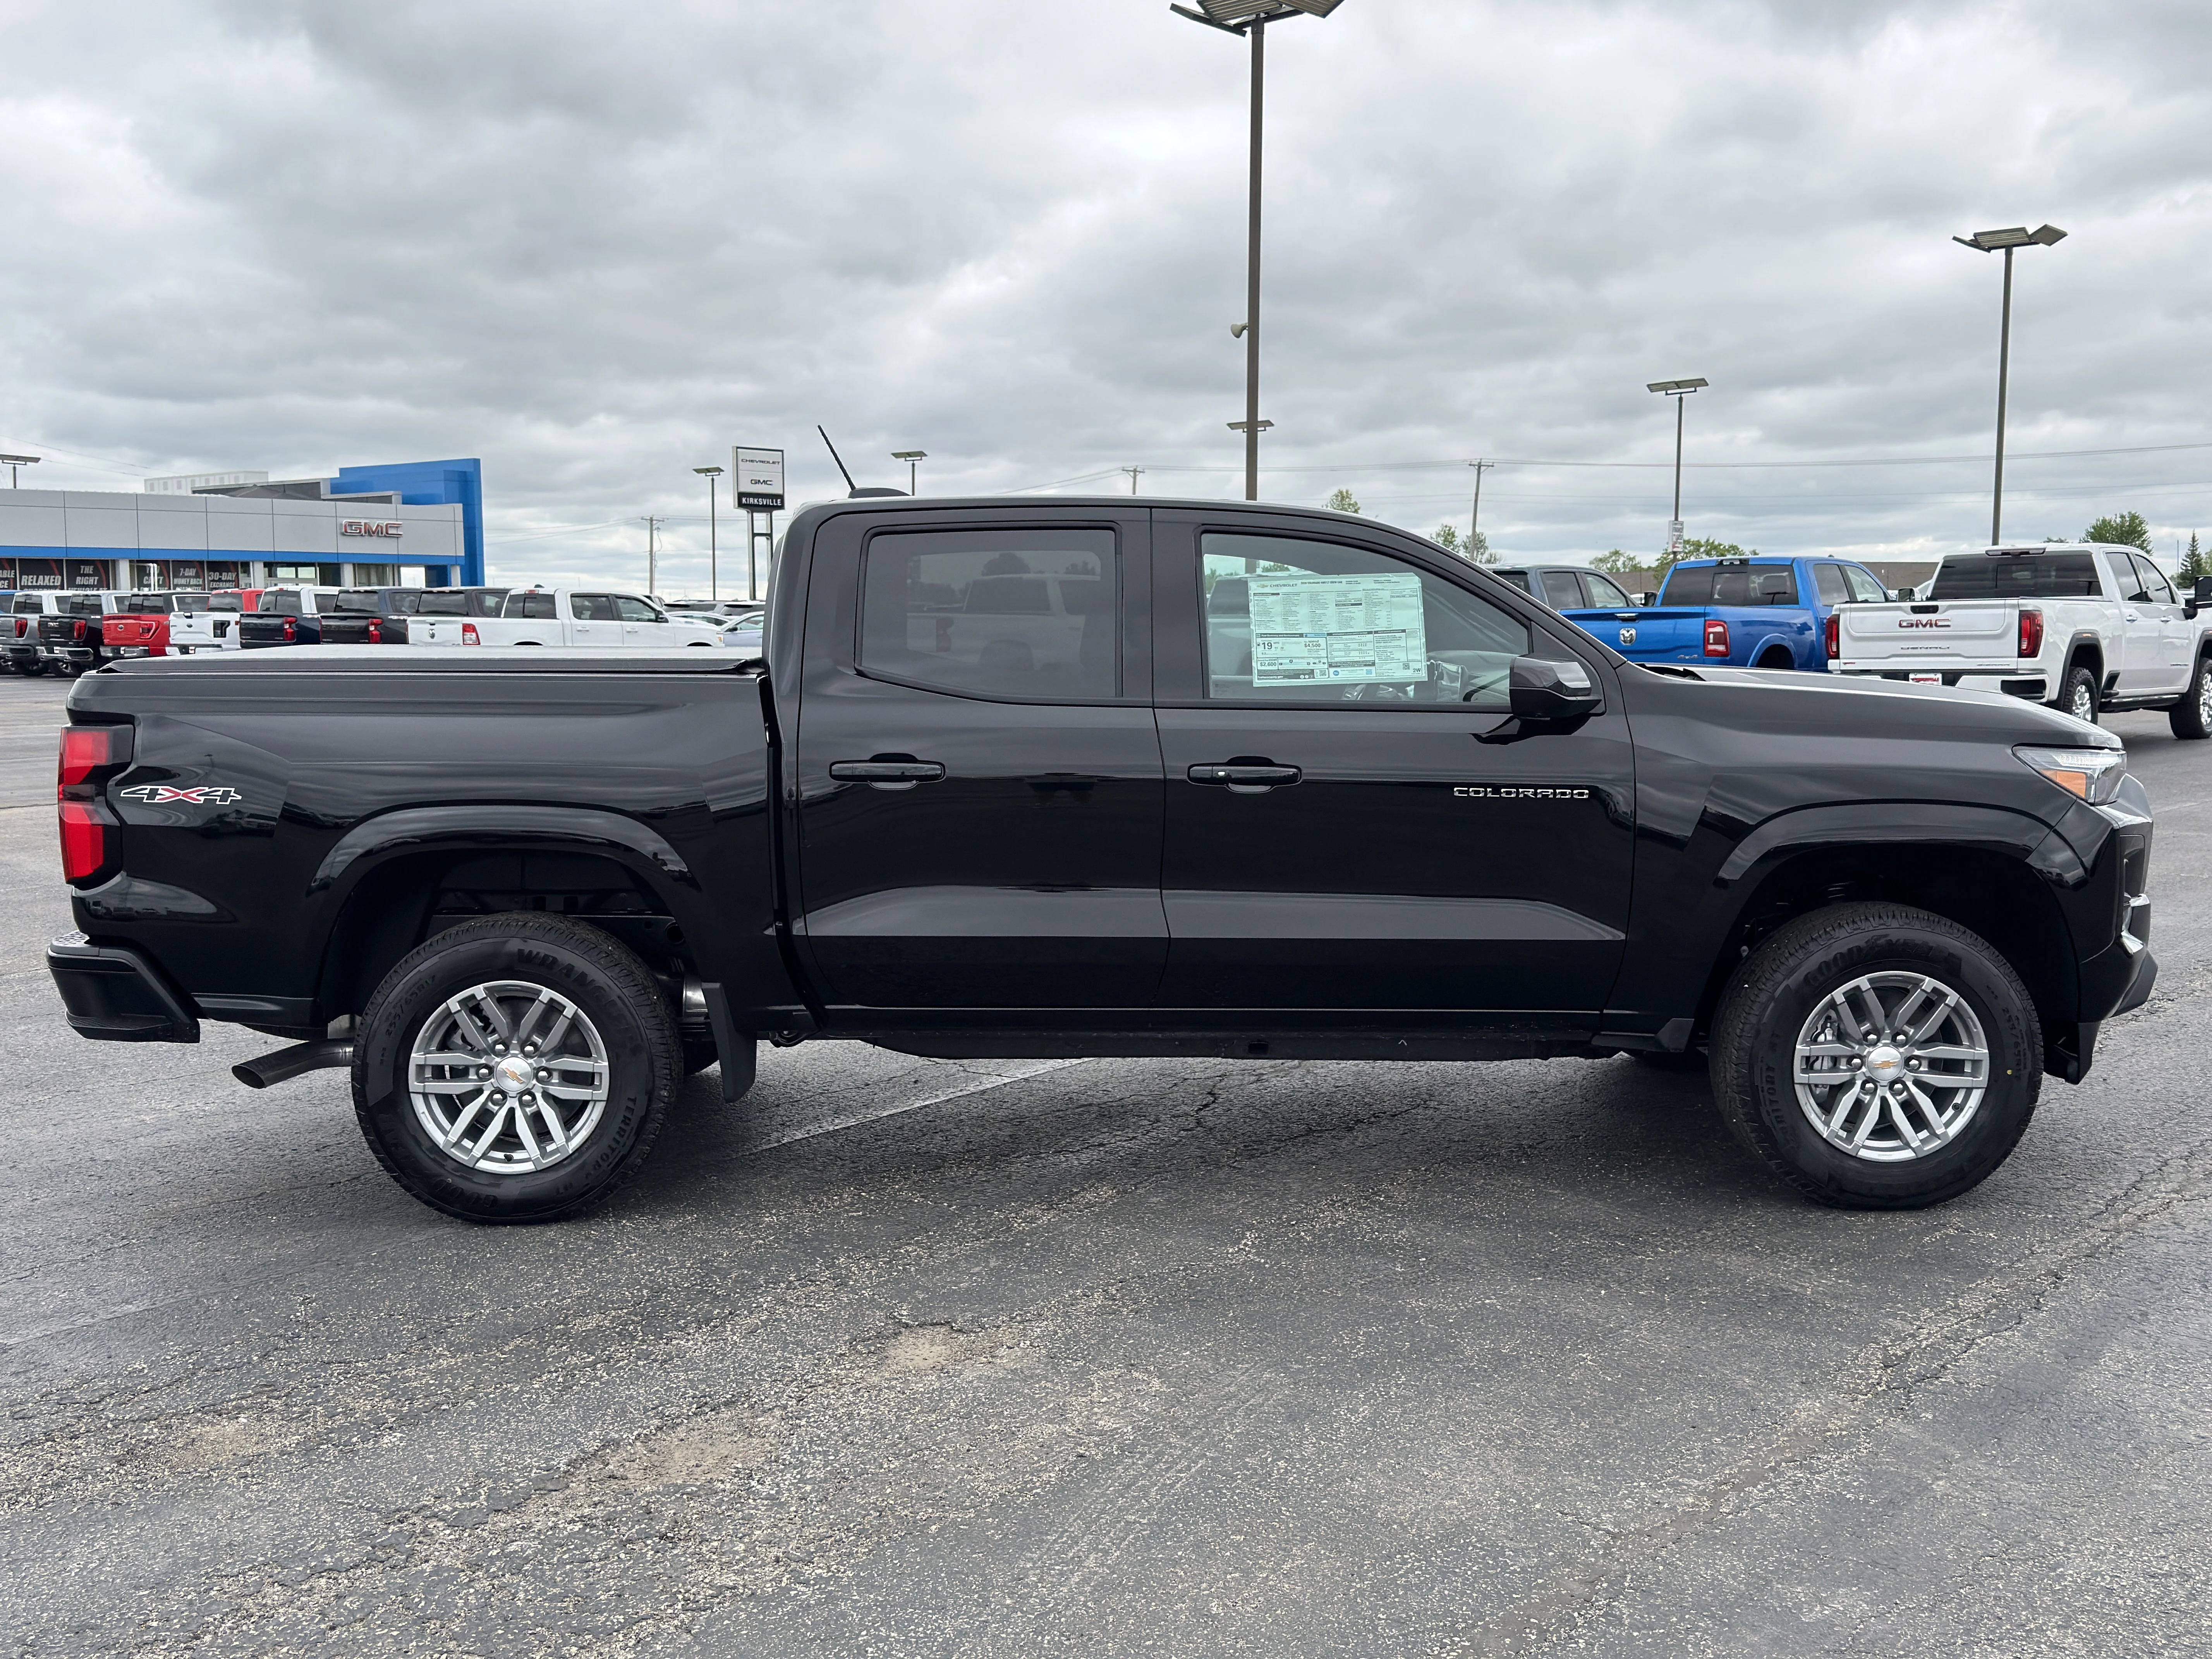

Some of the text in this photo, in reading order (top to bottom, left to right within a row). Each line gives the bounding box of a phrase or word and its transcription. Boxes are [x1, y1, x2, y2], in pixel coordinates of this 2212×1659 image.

[742, 497, 782, 506] KIRKSVILLE
[343, 520, 403, 538] GMC
[80, 565, 94, 574] THE
[147, 565, 160, 574] YU
[180, 568, 196, 576] 7-DAY
[21, 575, 62, 586] RELAXED
[76, 576, 100, 585] RIGHT
[208, 572, 237, 580] 30-DAY
[1898, 618, 1951, 628] GMC
[120, 785, 242, 805] 4X4
[1453, 787, 1589, 799] COLORADO
